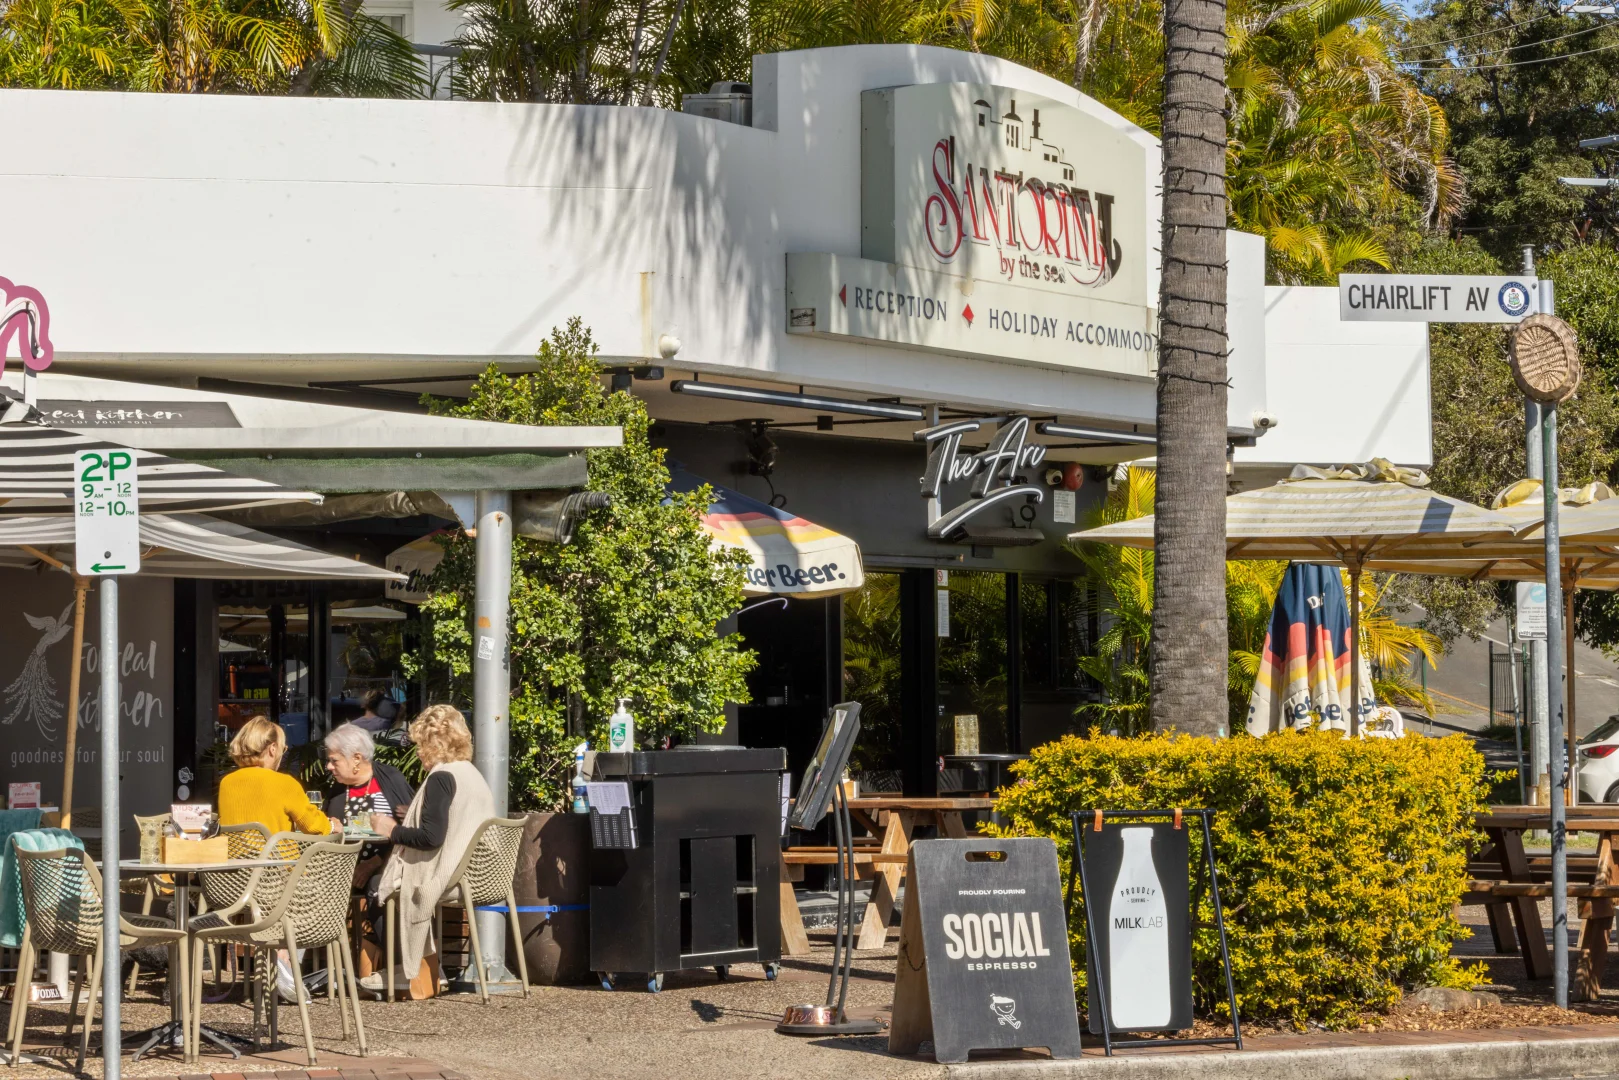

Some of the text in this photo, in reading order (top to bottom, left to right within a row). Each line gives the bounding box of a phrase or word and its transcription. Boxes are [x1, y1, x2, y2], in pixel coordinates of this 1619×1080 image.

[1000, 250, 1015, 281] by
[1018, 255, 1040, 279] the
[1348, 284, 1489, 311] CHAIRLIFT AV
[855, 287, 947, 322] RECEPTION
[989, 308, 1057, 339] HOLIDAY
[96, 409, 183, 420] kitchen
[80, 452, 132, 482] 2P
[918, 421, 981, 498] The
[776, 562, 846, 588] Beer.
[11, 747, 66, 768] goodnes
[77, 746, 96, 762] for
[138, 745, 165, 763] soul
[1120, 886, 1155, 897] PROUDLY
[943, 912, 1051, 960] SOCIAL
[967, 961, 1037, 971] ESPRESSO
